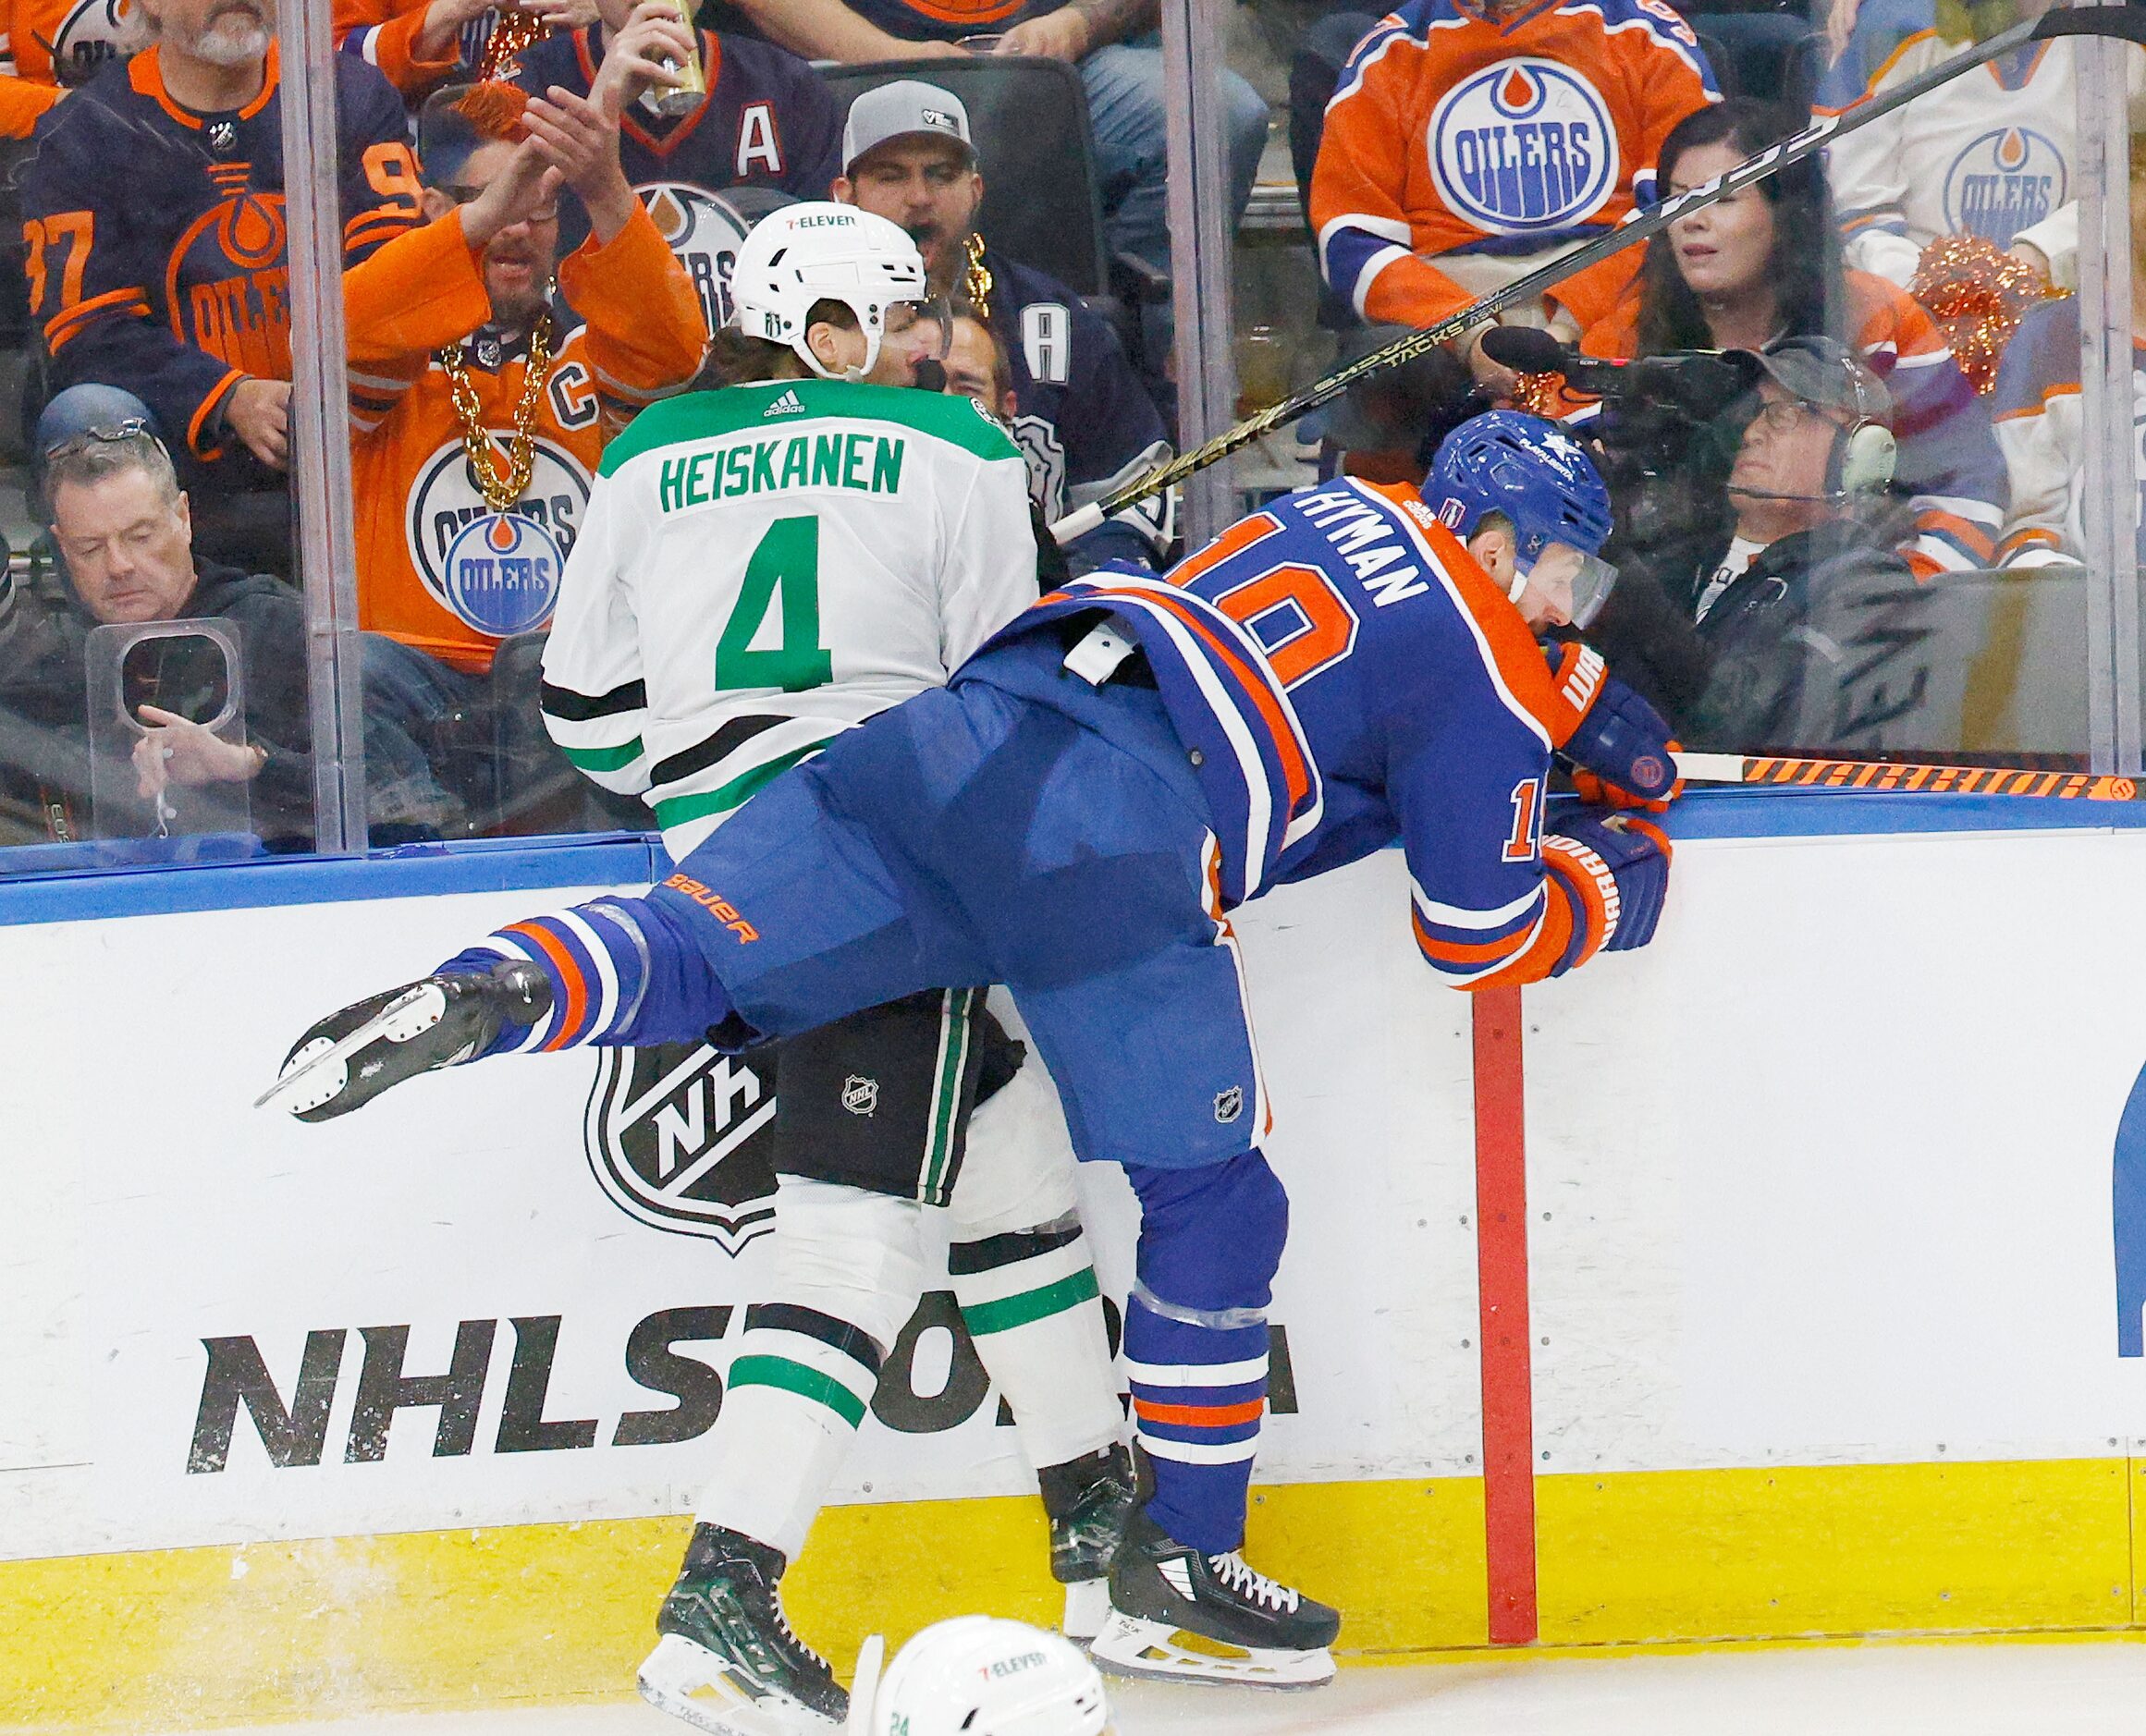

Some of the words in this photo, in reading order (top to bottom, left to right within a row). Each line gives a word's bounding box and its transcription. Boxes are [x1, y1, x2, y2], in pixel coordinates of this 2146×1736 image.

[736, 103, 783, 178] A
[1455, 122, 1591, 218] OILERS
[1961, 174, 2052, 252] OILERS
[191, 267, 292, 381] OILE
[1020, 302, 1071, 385] A
[1385, 319, 1465, 367] TACKS
[547, 361, 600, 432] C
[764, 405, 805, 417] adidas
[660, 434, 904, 513] HEISKANEN
[1293, 491, 1429, 607] HYMAN
[460, 557, 550, 625] OILERS
[715, 515, 833, 694] 4
[651, 1056, 761, 1180] NH
